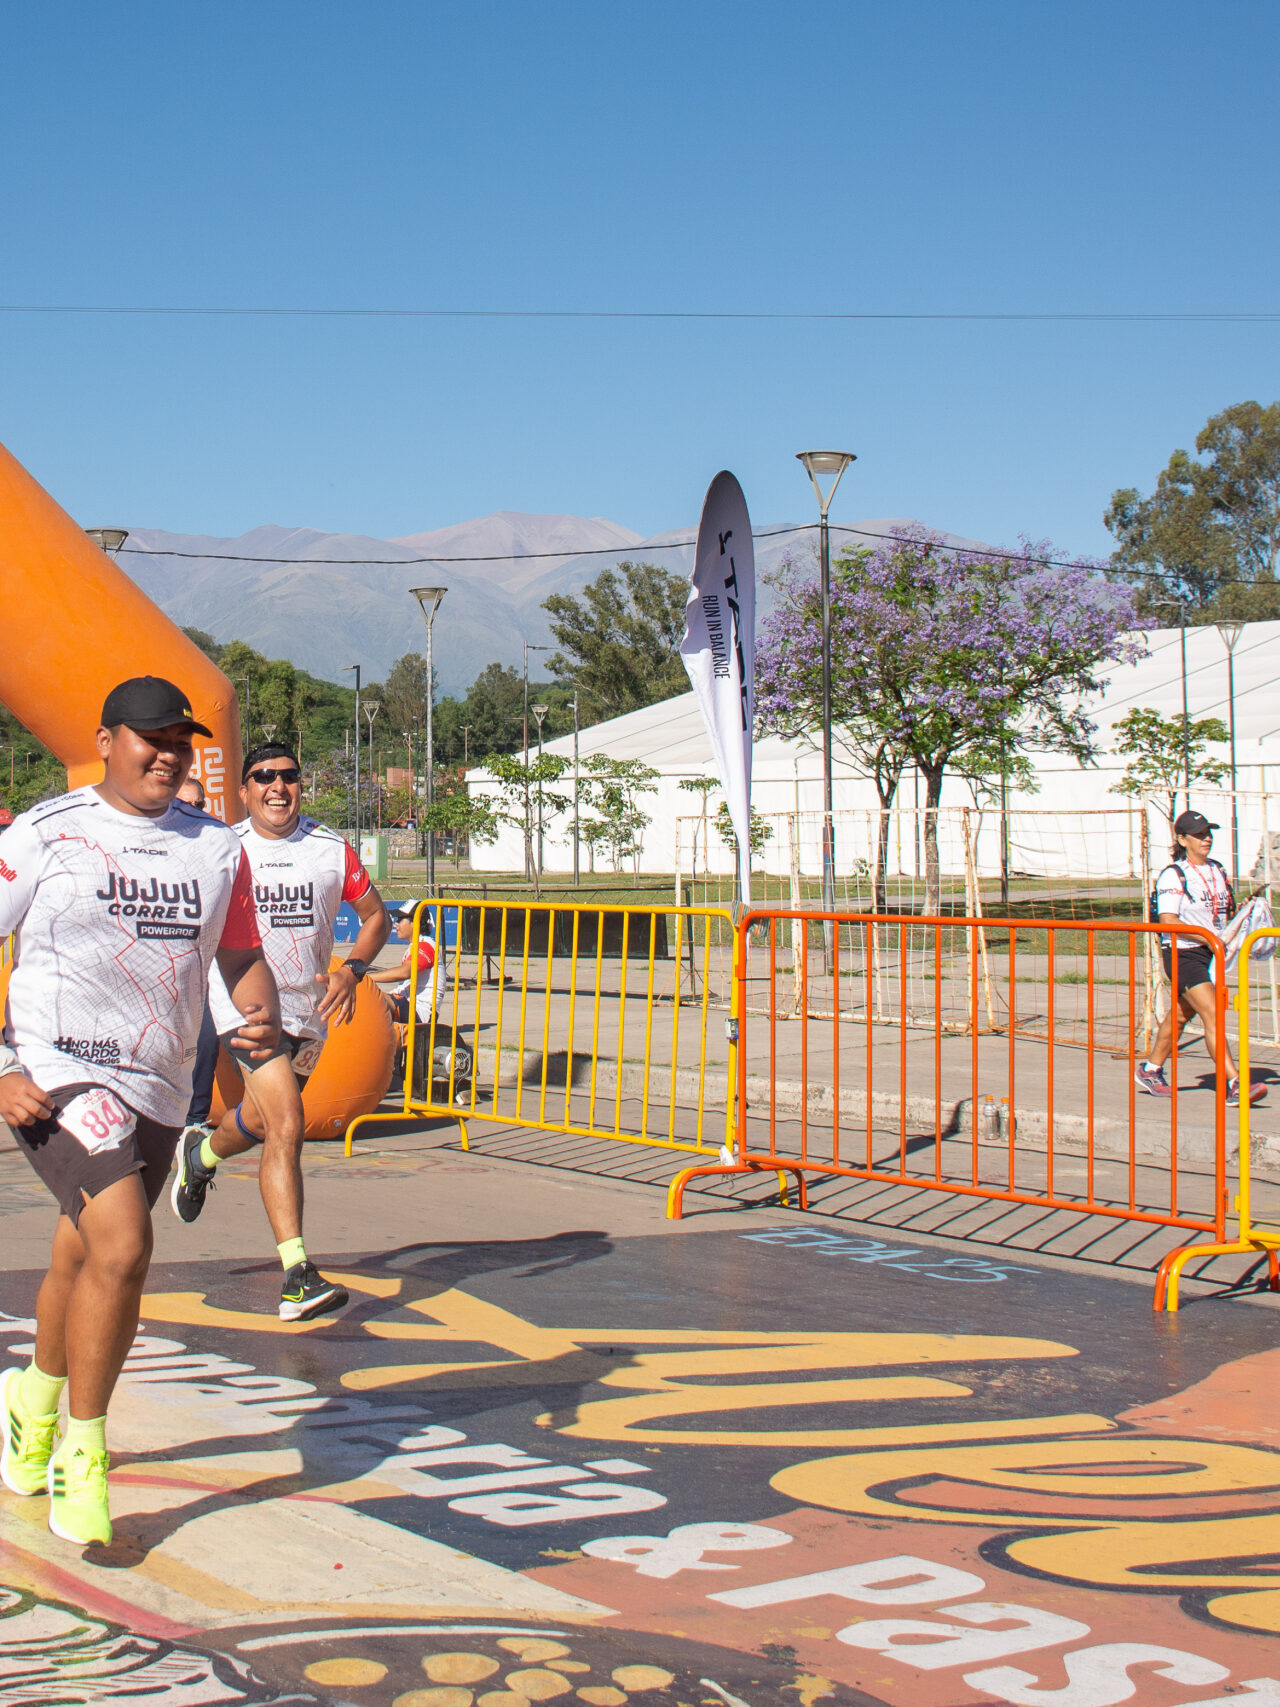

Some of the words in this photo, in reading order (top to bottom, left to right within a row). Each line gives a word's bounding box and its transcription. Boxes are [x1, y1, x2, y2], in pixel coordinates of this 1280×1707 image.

[702, 595, 719, 617] RUN
[706, 619, 721, 632] IN
[709, 633, 730, 680] BALANCE
[108, 903, 180, 918] CORRE
[92, 1036, 119, 1049] MÁS
[72, 1048, 120, 1058] BARDO
[580, 1522, 793, 1579] &
[706, 1555, 1280, 1707] Pas
